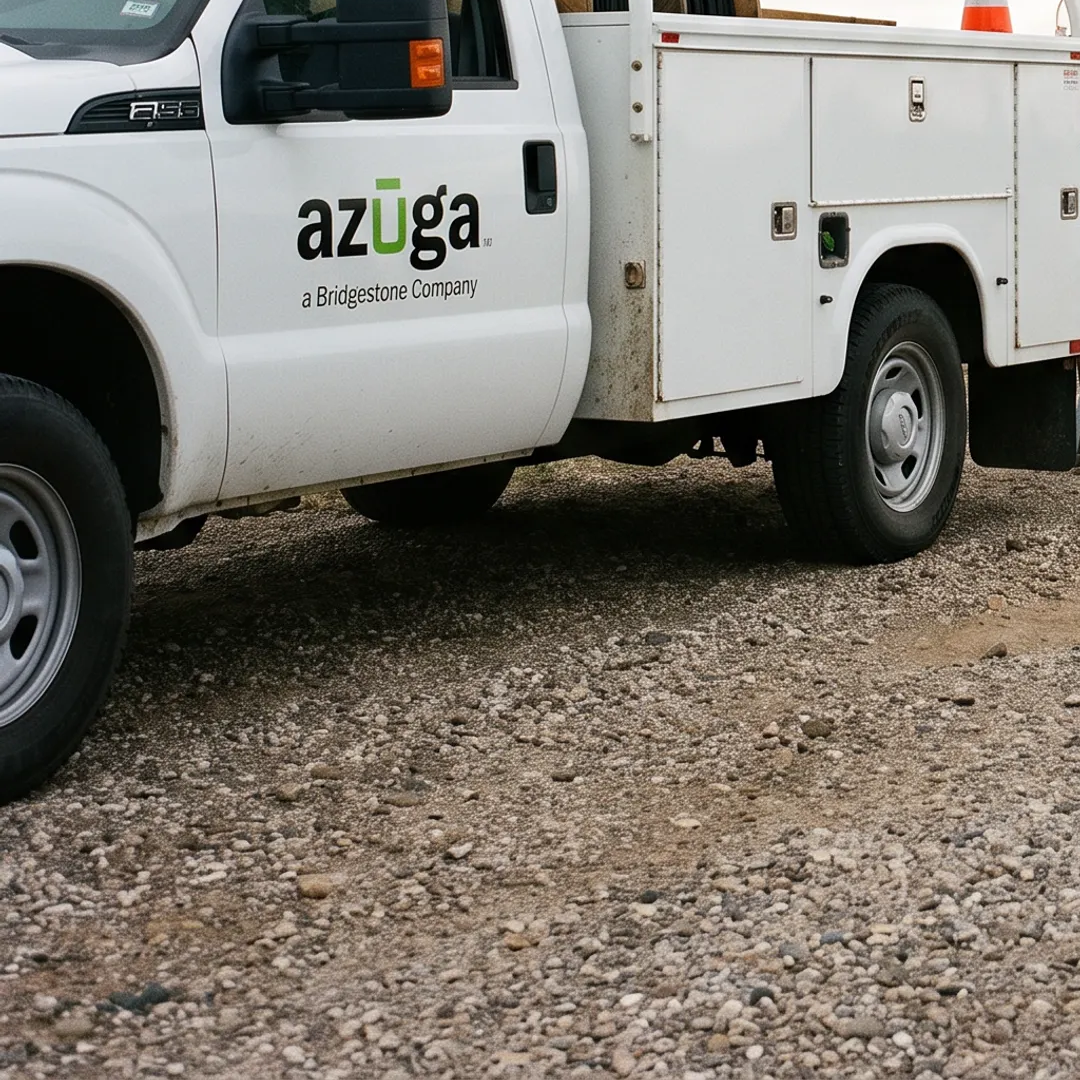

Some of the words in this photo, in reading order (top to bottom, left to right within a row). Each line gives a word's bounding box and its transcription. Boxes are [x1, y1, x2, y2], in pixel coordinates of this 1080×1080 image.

[301, 291, 312, 309] a
[316, 282, 408, 310] Bridgestone
[411, 278, 478, 301] Company
